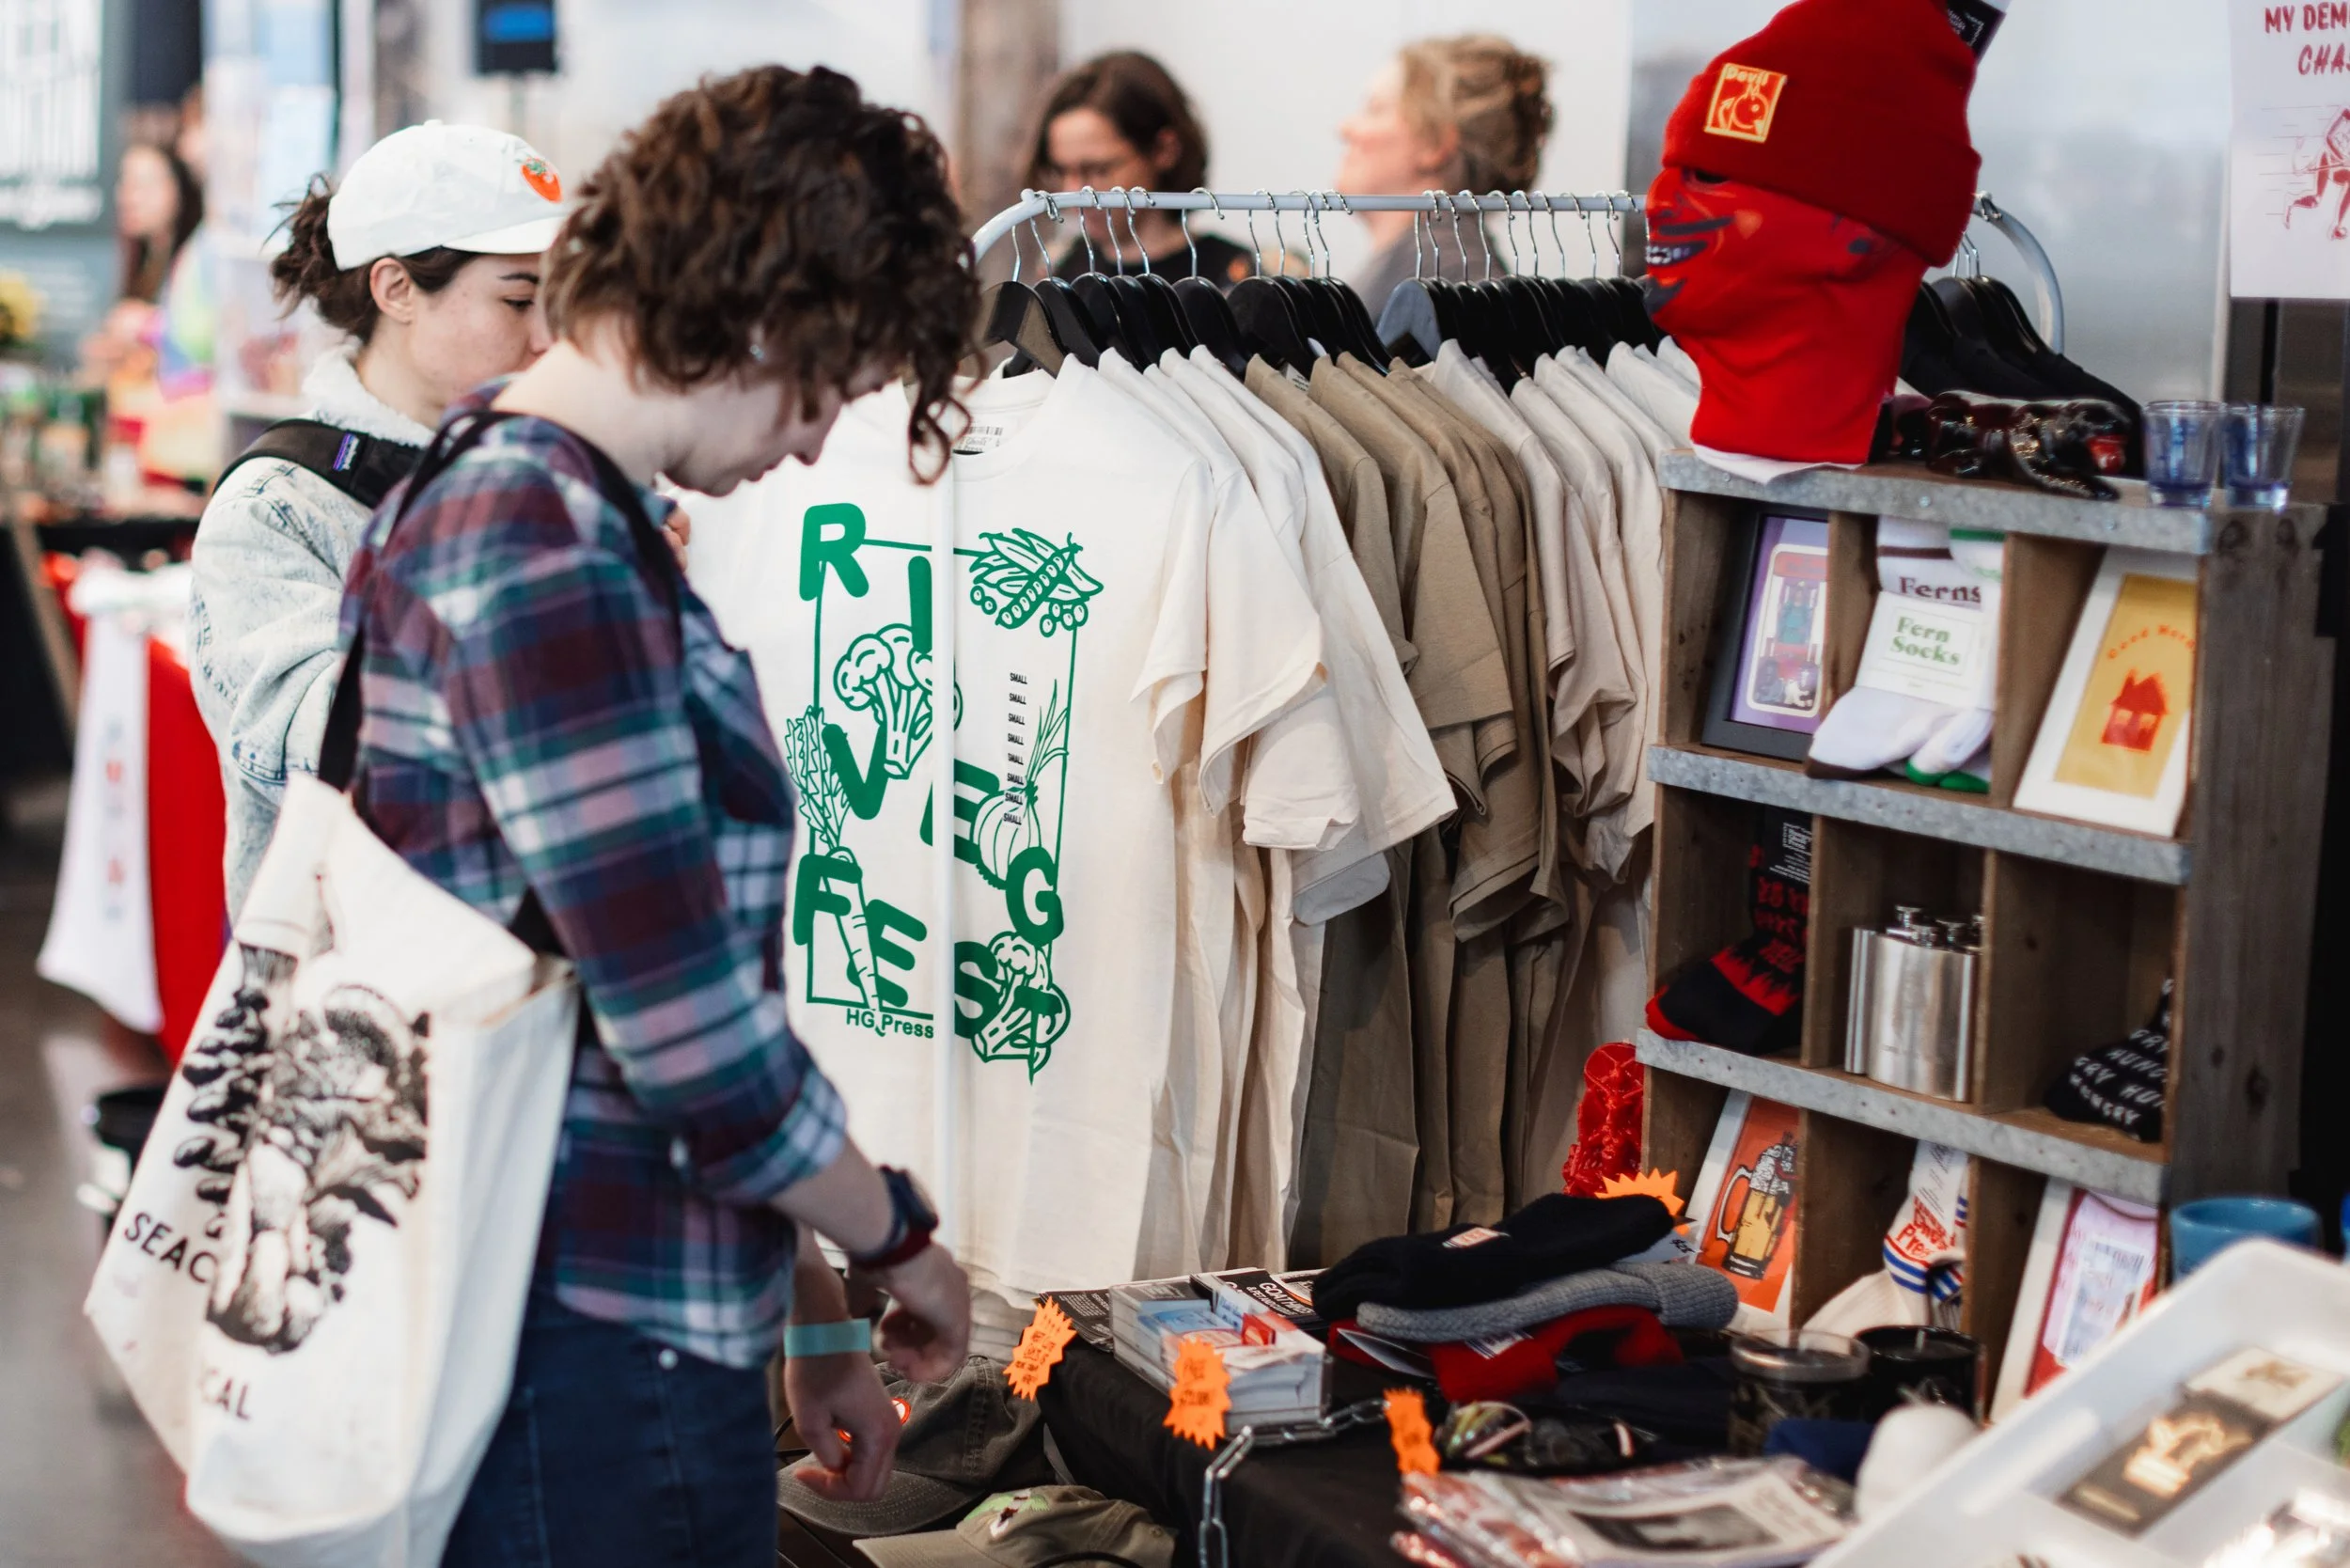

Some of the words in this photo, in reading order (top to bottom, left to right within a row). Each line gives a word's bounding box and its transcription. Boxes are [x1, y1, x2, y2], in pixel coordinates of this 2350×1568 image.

[2264, 5, 2295, 34] MY
[2303, 1, 2350, 31] DEM
[1899, 575, 1982, 604] Ferns
[1896, 616, 1951, 643] Fern
[1889, 635, 1961, 665] Socks
[1010, 672, 1027, 684] SMALL
[1009, 693, 1026, 705] SMALL
[1008, 713, 1026, 725] SMALL
[1007, 732, 1024, 745] SMALL
[1007, 753, 1024, 765] SMALL
[1007, 773, 1025, 786] SMALL
[1005, 792, 1024, 806] SMALL
[1003, 812, 1022, 825] SMALL
[846, 1008, 875, 1028] HG
[882, 1013, 934, 1040] Press
